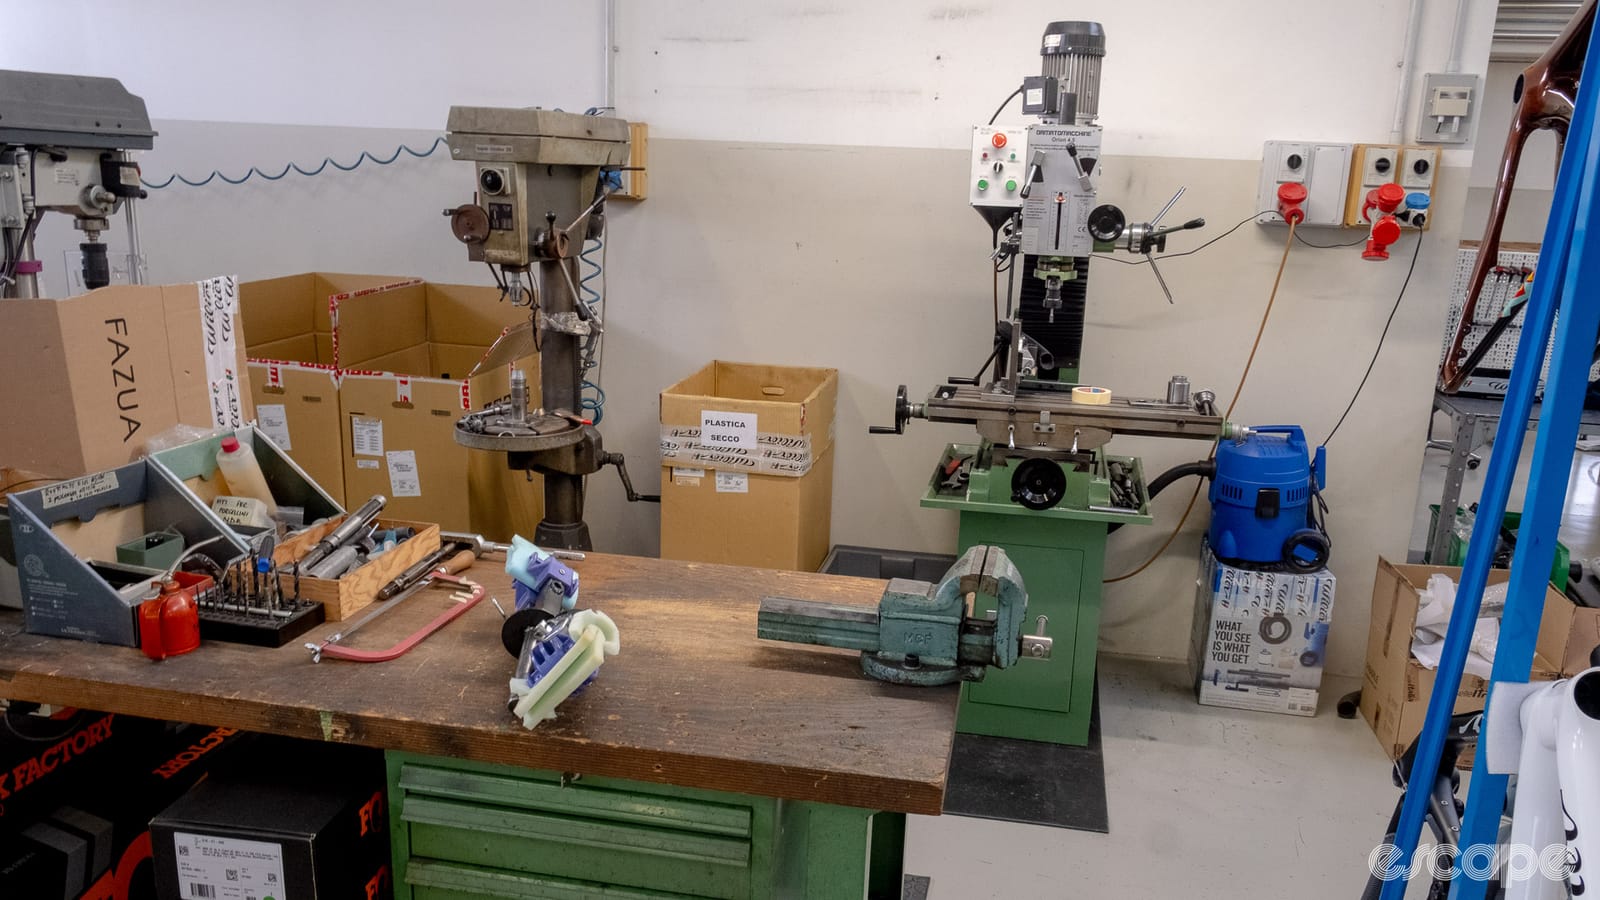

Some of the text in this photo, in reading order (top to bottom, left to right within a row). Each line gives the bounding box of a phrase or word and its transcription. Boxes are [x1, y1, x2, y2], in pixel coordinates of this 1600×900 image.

[104, 318, 141, 443] FAZUA
[704, 419, 746, 429] PLASTICA
[710, 434, 740, 443] SECCO
[1215, 620, 1243, 632] WHAT
[1215, 630, 1252, 644] YOU SEE
[1212, 641, 1251, 654] IS WHAT
[1211, 651, 1250, 665] YOU GET
[12, 713, 114, 792] FACTORY
